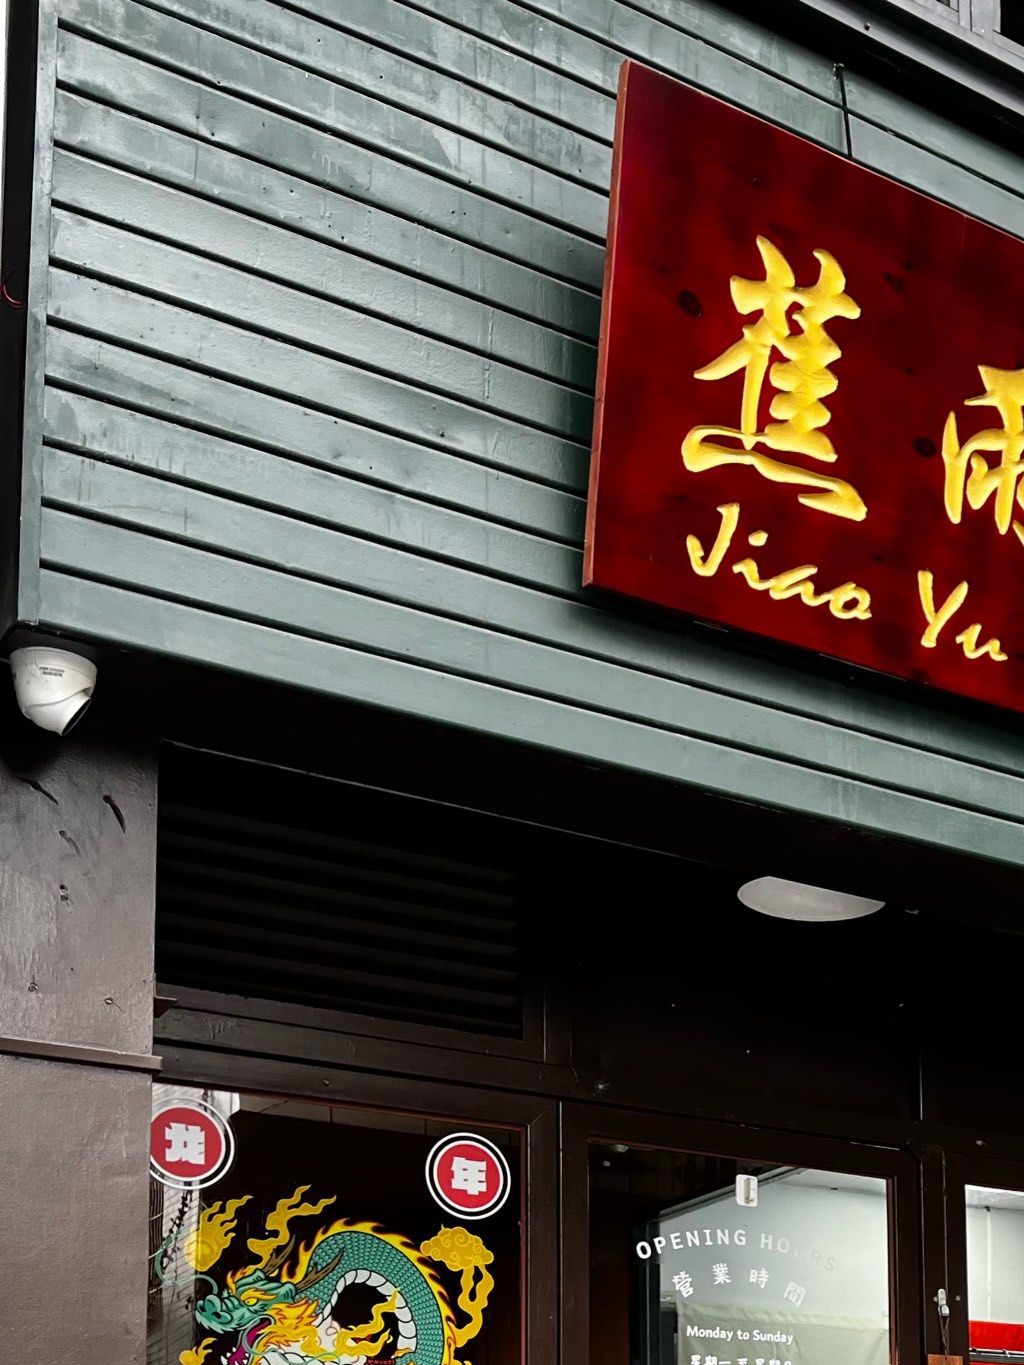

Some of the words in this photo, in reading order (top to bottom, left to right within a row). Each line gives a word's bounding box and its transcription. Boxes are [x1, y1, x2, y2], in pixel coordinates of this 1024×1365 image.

[686, 503, 872, 620] Jiao
[918, 569, 1008, 661] Yu
[451, 1156, 488, 1197] 年
[636, 1229, 747, 1260] OPENING
[760, 1233, 837, 1272] HORS
[671, 1262, 807, 1308] 營業時間
[686, 1325, 734, 1342] Monday
[736, 1329, 750, 1341] to
[752, 1330, 794, 1346] Sunday
